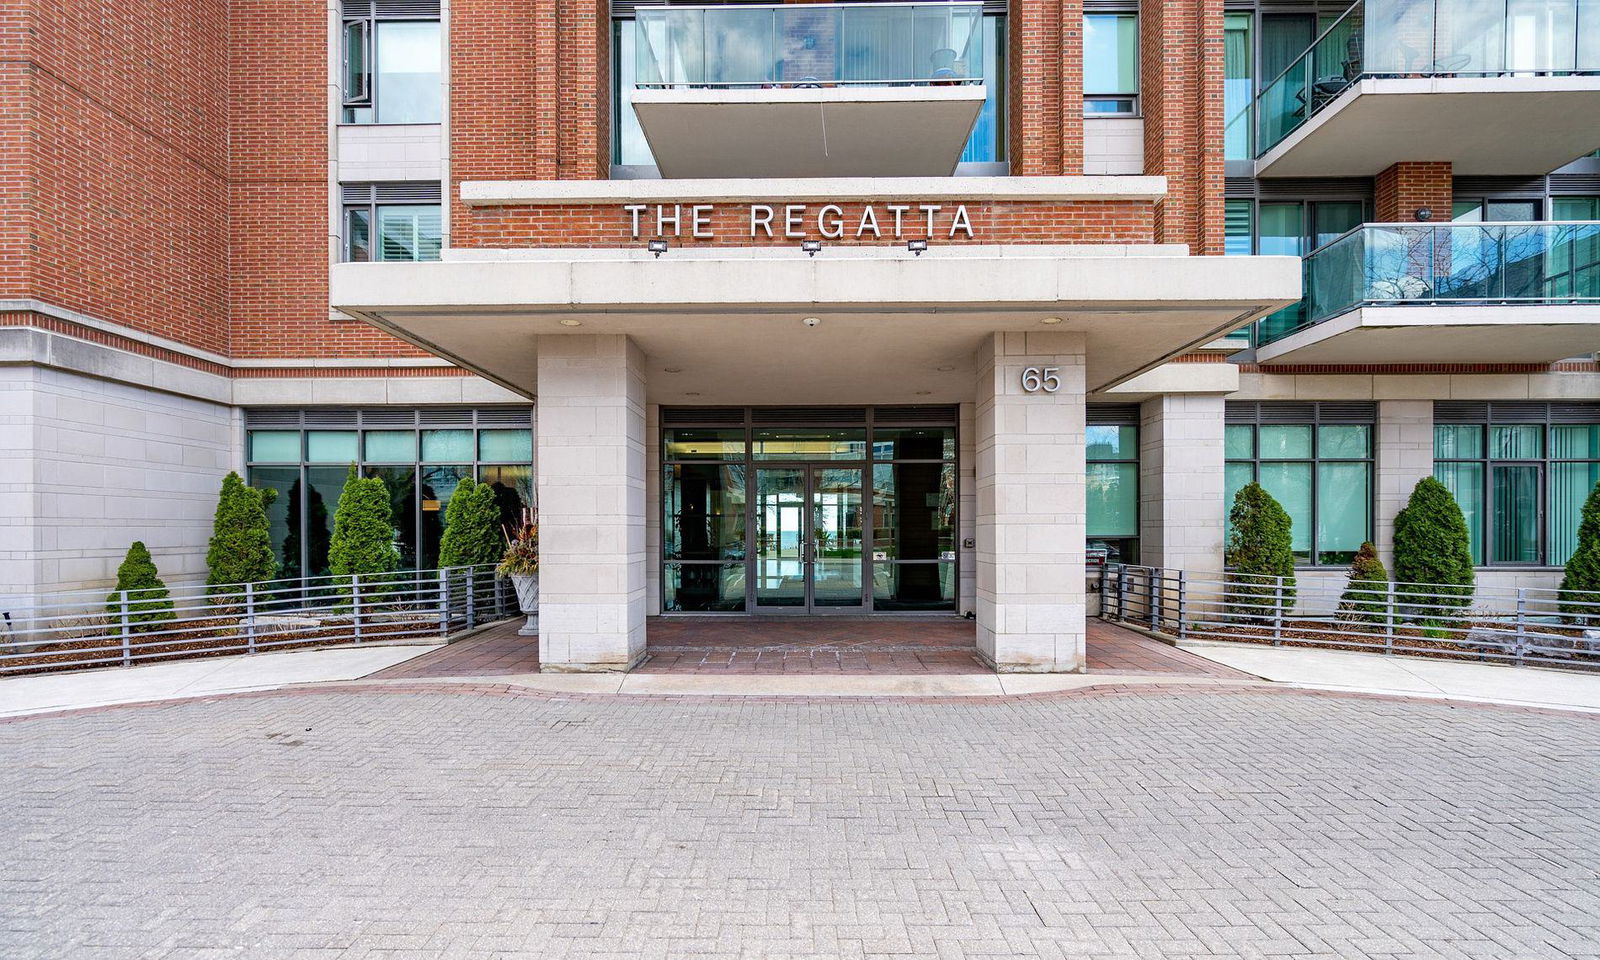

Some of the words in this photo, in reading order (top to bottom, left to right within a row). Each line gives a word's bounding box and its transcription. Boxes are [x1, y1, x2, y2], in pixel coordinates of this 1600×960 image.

[624, 204, 714, 238] THE
[750, 204, 975, 239] REGATTA
[1021, 367, 1061, 393] 65
